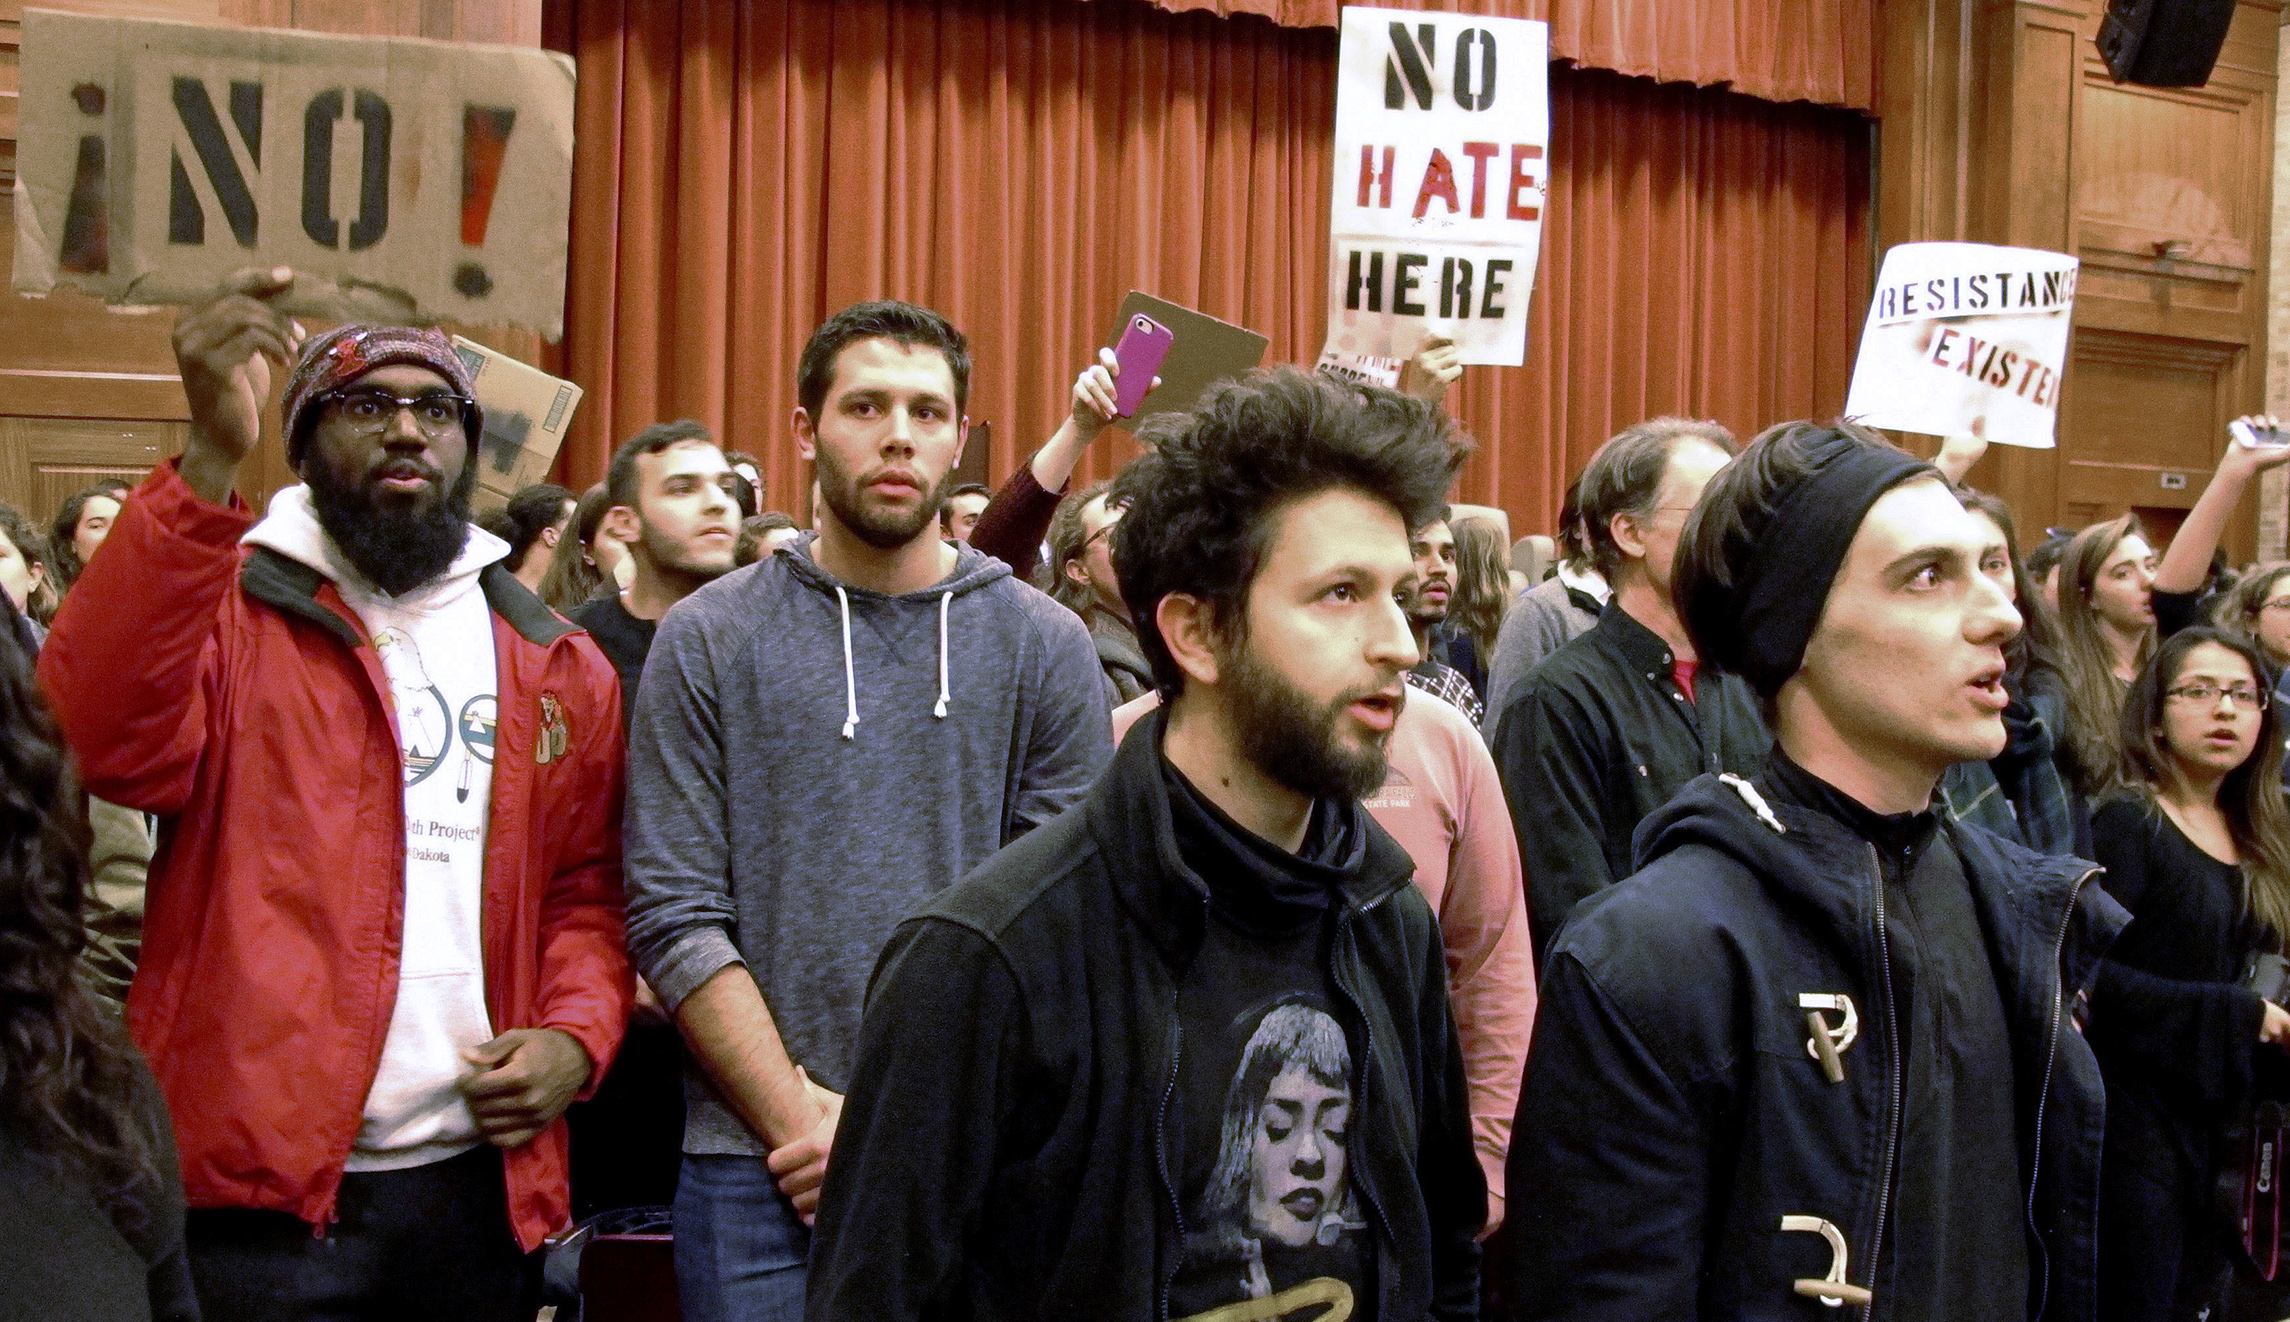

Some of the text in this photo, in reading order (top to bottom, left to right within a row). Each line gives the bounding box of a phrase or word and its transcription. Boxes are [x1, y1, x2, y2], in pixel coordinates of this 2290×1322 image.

[1384, 20, 1498, 113] NO
[1356, 141, 1544, 222] HATE
[1345, 249, 1514, 320] HERE
[412, 847, 450, 863] Dakota
